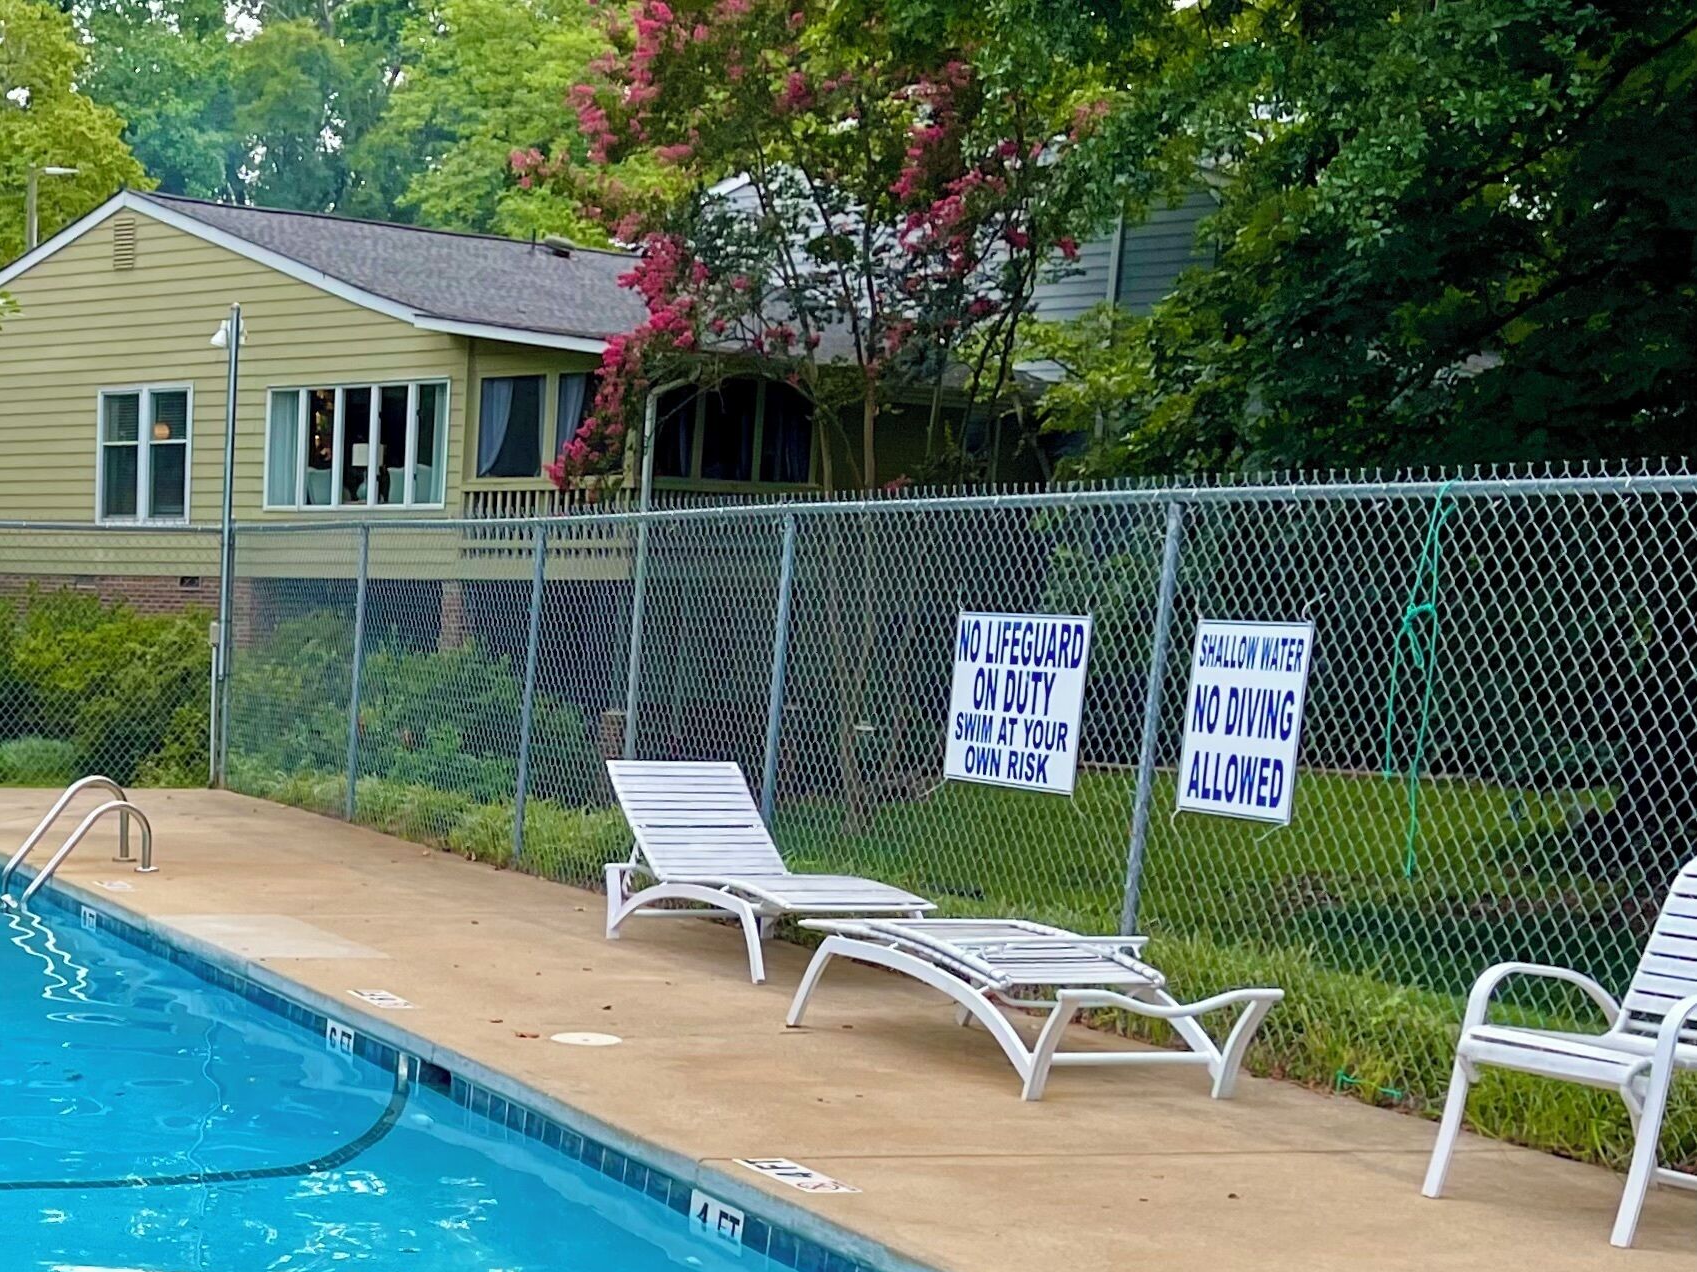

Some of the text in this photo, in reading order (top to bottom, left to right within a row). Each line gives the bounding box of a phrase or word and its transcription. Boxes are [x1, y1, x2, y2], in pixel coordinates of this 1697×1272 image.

[958, 619, 1084, 668] NO LIFEGUARD
[1199, 634, 1305, 672] SHALLOW WATER
[973, 667, 1057, 717] ON DUTY
[1192, 684, 1295, 741] NO DIVING
[955, 712, 1068, 752] SWIM AT YOUR
[965, 745, 1050, 784] OWN RISK
[1186, 750, 1284, 808] ALLOWED
